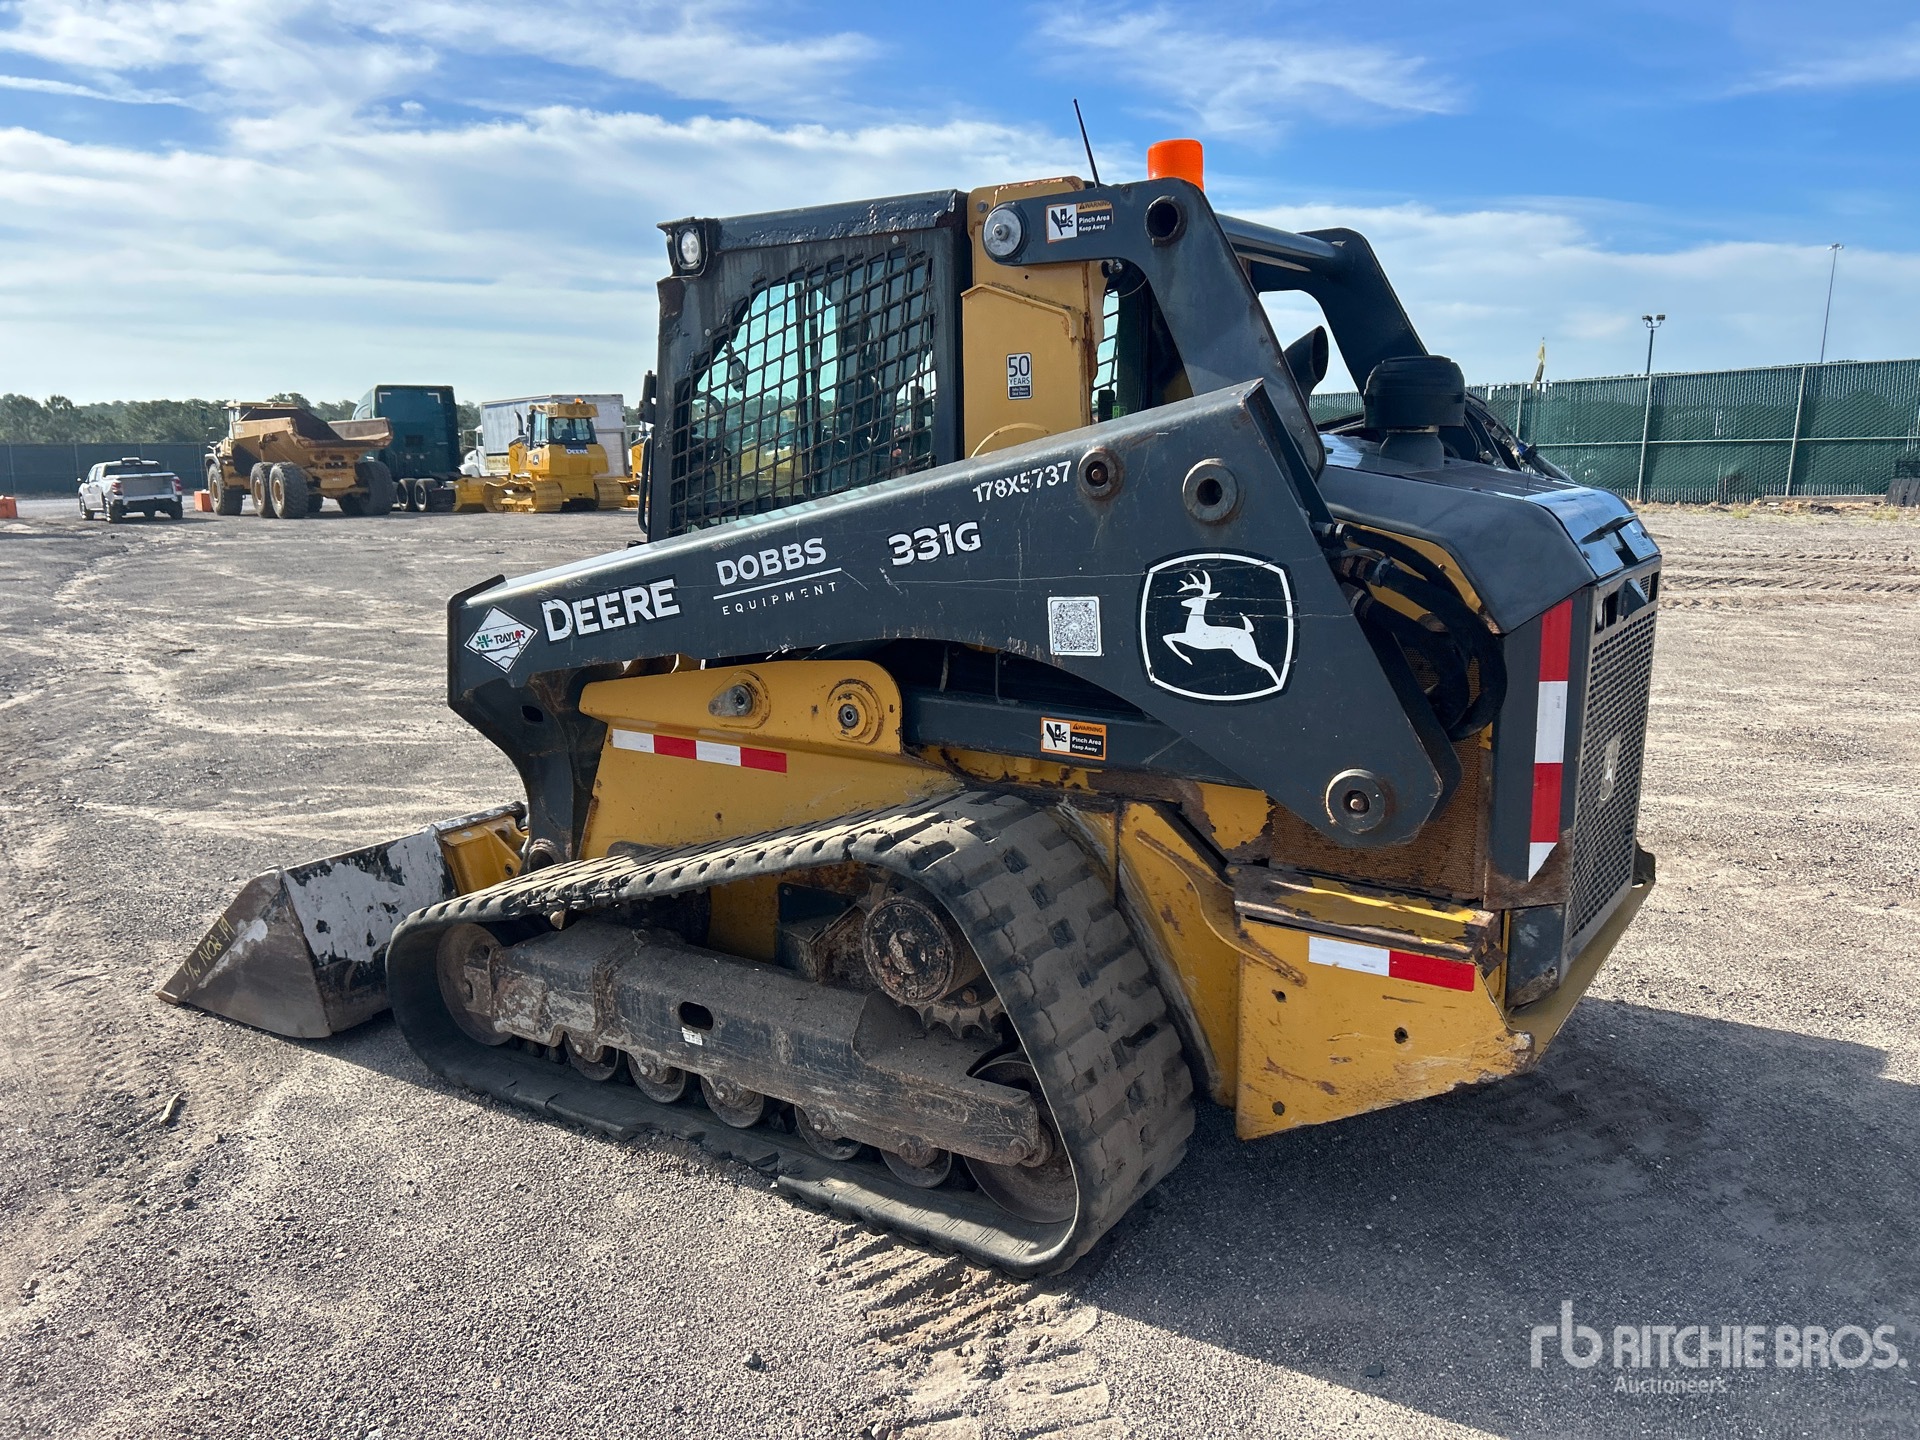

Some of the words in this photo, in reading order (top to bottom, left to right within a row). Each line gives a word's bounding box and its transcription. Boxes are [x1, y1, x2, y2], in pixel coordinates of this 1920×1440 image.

[1084, 200, 1111, 209] WARNING
[1079, 216, 1095, 224] Pinch
[1096, 214, 1110, 222] Area
[1008, 355, 1030, 378] 50
[1009, 377, 1030, 386] YEARS
[972, 460, 1072, 503] 178X5737
[888, 521, 982, 566] 331G
[715, 537, 827, 587] DOBBS
[722, 581, 837, 616] EQUIPMENT
[541, 578, 681, 642] DEERE
[494, 629, 526, 645] TRAYLOR
[1078, 724, 1104, 733] WARNING
[1072, 736, 1088, 744] Pinch
[1088, 738, 1102, 746] Area
